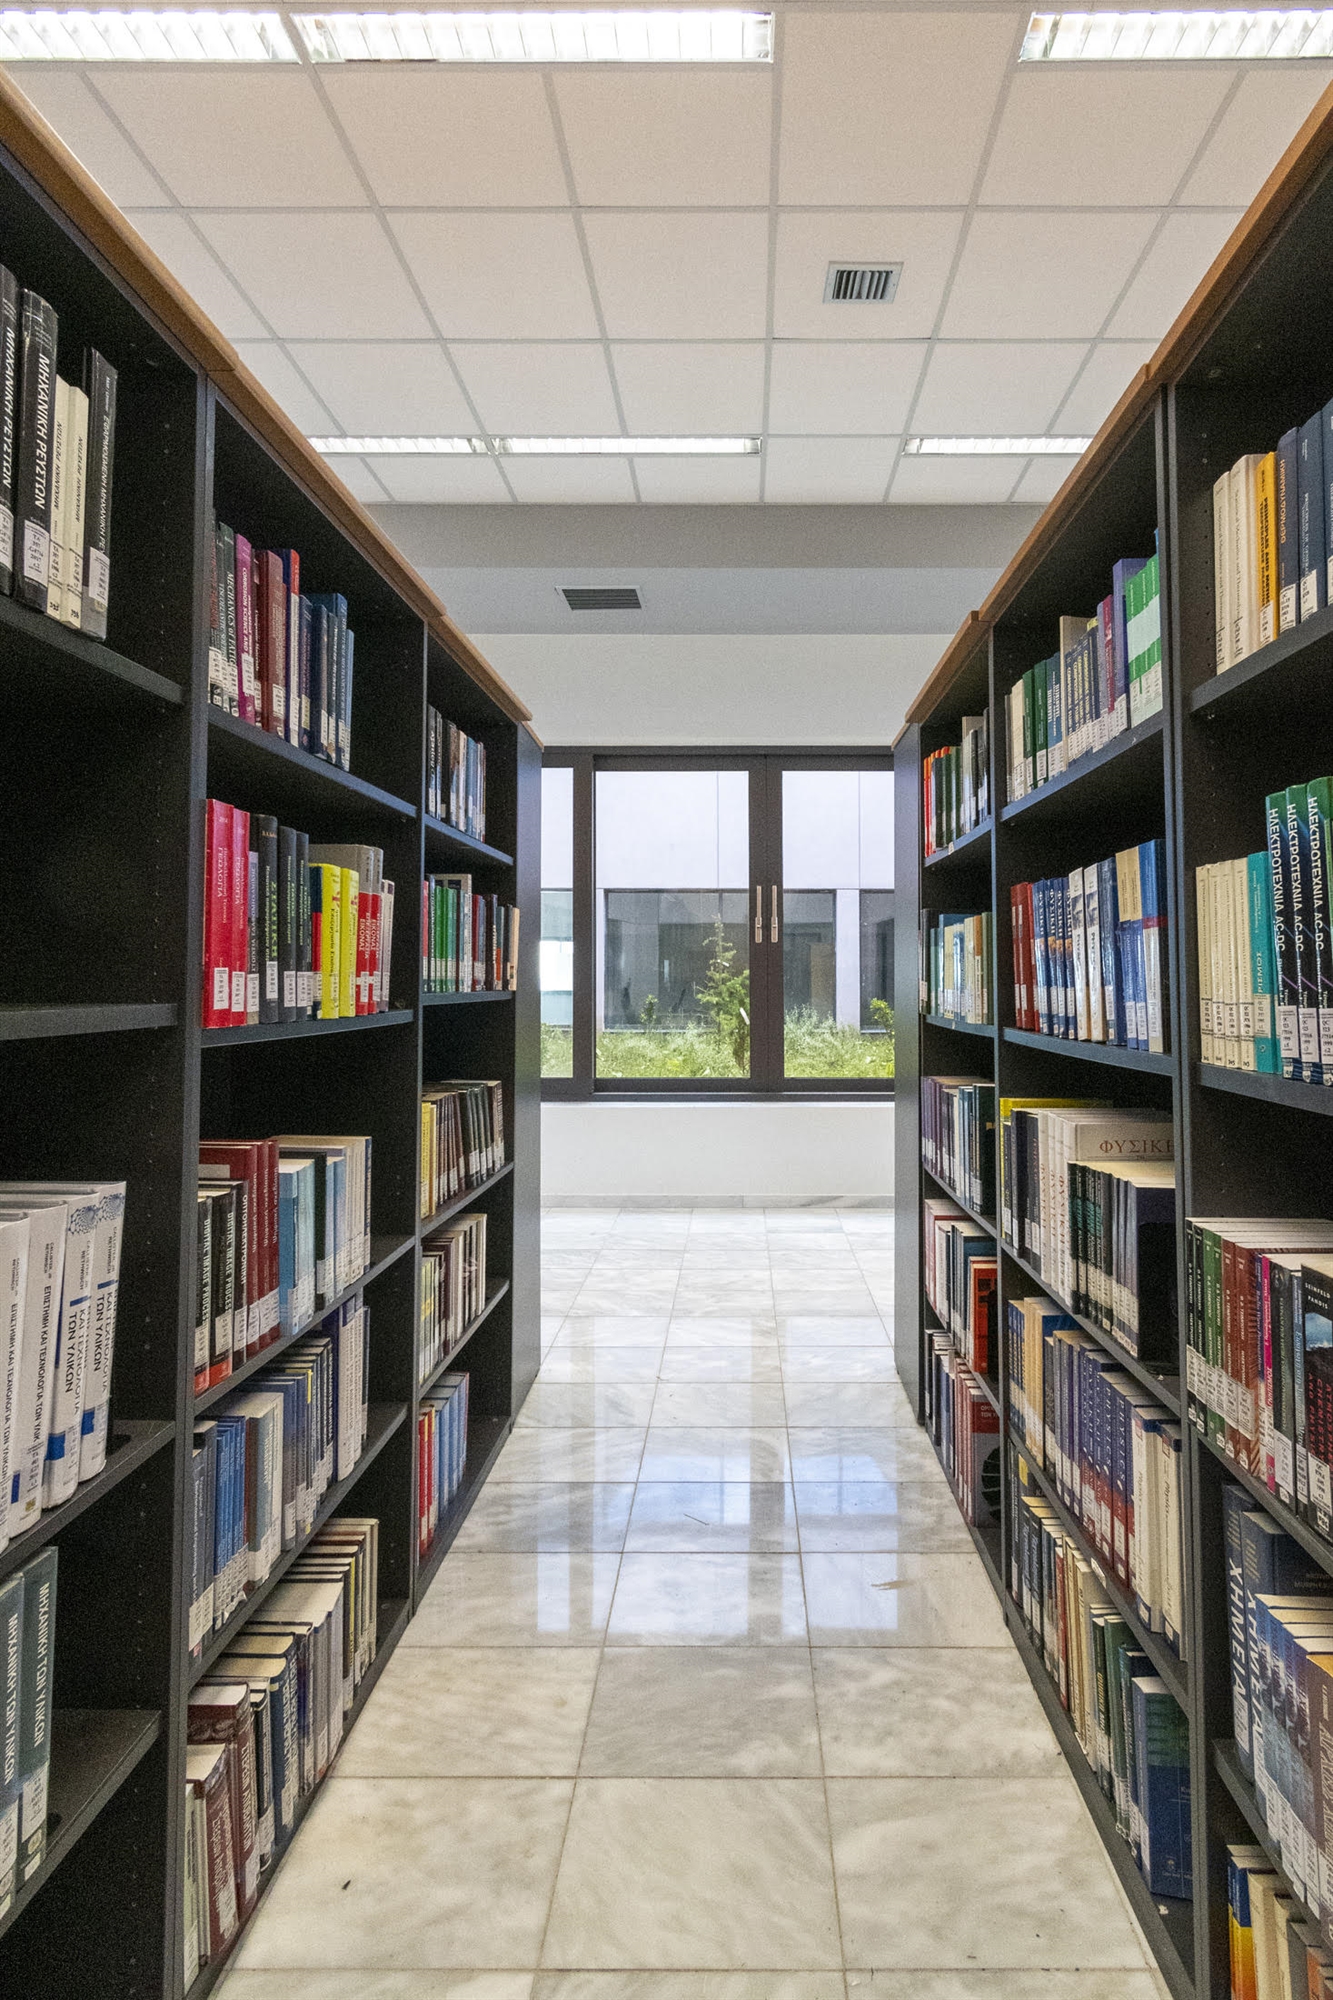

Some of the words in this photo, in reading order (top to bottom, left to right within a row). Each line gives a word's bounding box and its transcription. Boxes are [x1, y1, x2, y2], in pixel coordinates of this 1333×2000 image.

[4, 327, 16, 417] ΜΗΧΑΝΙΚΗ
[37, 353, 50, 439] ΜΗΧΑΝΙΚΗ
[2, 416, 14, 489] ΡΕΥΣΤΩΝ
[101, 415, 110, 487] ΕΦΑΡΜΟΣΜΕΝΗ
[34, 439, 48, 510] ΡΕΥΣΤΩΝ
[100, 487, 108, 536] ΜΗΧΑΝΙΚΗ
[1280, 459, 1288, 545] ΘΕΡΜΟΔΥΝΑΜΙΚΗ
[226, 571, 235, 626] MECHANICS
[228, 628, 235, 636] of
[1269, 808, 1284, 913] ΗΛΕΚΤΡΟΤΕΧΝΙΑ
[1287, 803, 1303, 911] ΗΛΕΚΤΡΟΤΕΧΝΙΑ
[1308, 796, 1323, 908] ΗΛΕΚΤΡΟΤΕΧΝΙΑ
[1276, 915, 1285, 951] AC-DC
[1294, 915, 1304, 952] AC-DC
[1314, 912, 1324, 951] AC-DC
[203, 1218, 211, 1252] DIGITAL
[226, 1212, 234, 1245] DIGITAL
[202, 1254, 210, 1284] IMAGE
[225, 1247, 233, 1276] IMAGE
[42, 1286, 52, 1329] ΕΠΙΣΤΗΜΗ
[95, 1295, 105, 1323] ΤΩΝ
[105, 1291, 113, 1311] ΚΑΙ
[202, 1287, 210, 1324] PROCESS
[224, 1278, 233, 1315] PROCESS
[1305, 1282, 1331, 1299] SEINFELD
[1308, 1295, 1328, 1310] PANDIS
[9, 1303, 19, 1348] ΕΠΙΣΤΗΜΗ
[40, 1331, 48, 1345] ΚΑΙ
[68, 1312, 78, 1340] ΤΩΝ
[77, 1308, 86, 1329] ΚΑΙ
[7, 1350, 15, 1366] ΚΑΙ
[64, 1345, 76, 1394] ΥΛΙΚΩΝ
[93, 1326, 103, 1372] ΥΛΙΚΩΝ
[102, 1316, 112, 1393] ΤΕΧΝΟΛΟΓΙΑ
[36, 1348, 47, 1398] ΤΕΧΝΟΛΟΓΙΑ
[75, 1334, 85, 1415] ΤΕΧΝΟΛΟΓΙΑ
[4, 1368, 15, 1425] ΤΕΧΝΟΛΟΓΙΑ
[34, 1402, 44, 1418] ΤΩΝ
[3, 1426, 11, 1445] ΤΩΝ
[33, 1418, 42, 1442] ΥΛΙΚ
[1103, 1387, 1112, 1466] PHYSICS
[1117, 1400, 1126, 1482] PHYSICS
[1317, 1378, 1325, 1461] CHEMISTRY
[0, 1446, 9, 1480] ΥΛΙΚΩΝ
[1163, 1481, 1171, 1513] Physics
[37, 1582, 50, 1658] ΜΗΧΑΝΙΚΗ
[1229, 1558, 1246, 1698] ΧΗΜΕΙΑ
[6, 1613, 18, 1690] ΜΗΧΑΝΙΚΗ
[36, 1657, 47, 1691] ΤΩΝ
[6, 1690, 17, 1726] ΤΩΝ
[34, 1691, 46, 1748] ΥΛΙΚΩΝ
[4, 1726, 16, 1786] ΥΛΙΚΩΝ
